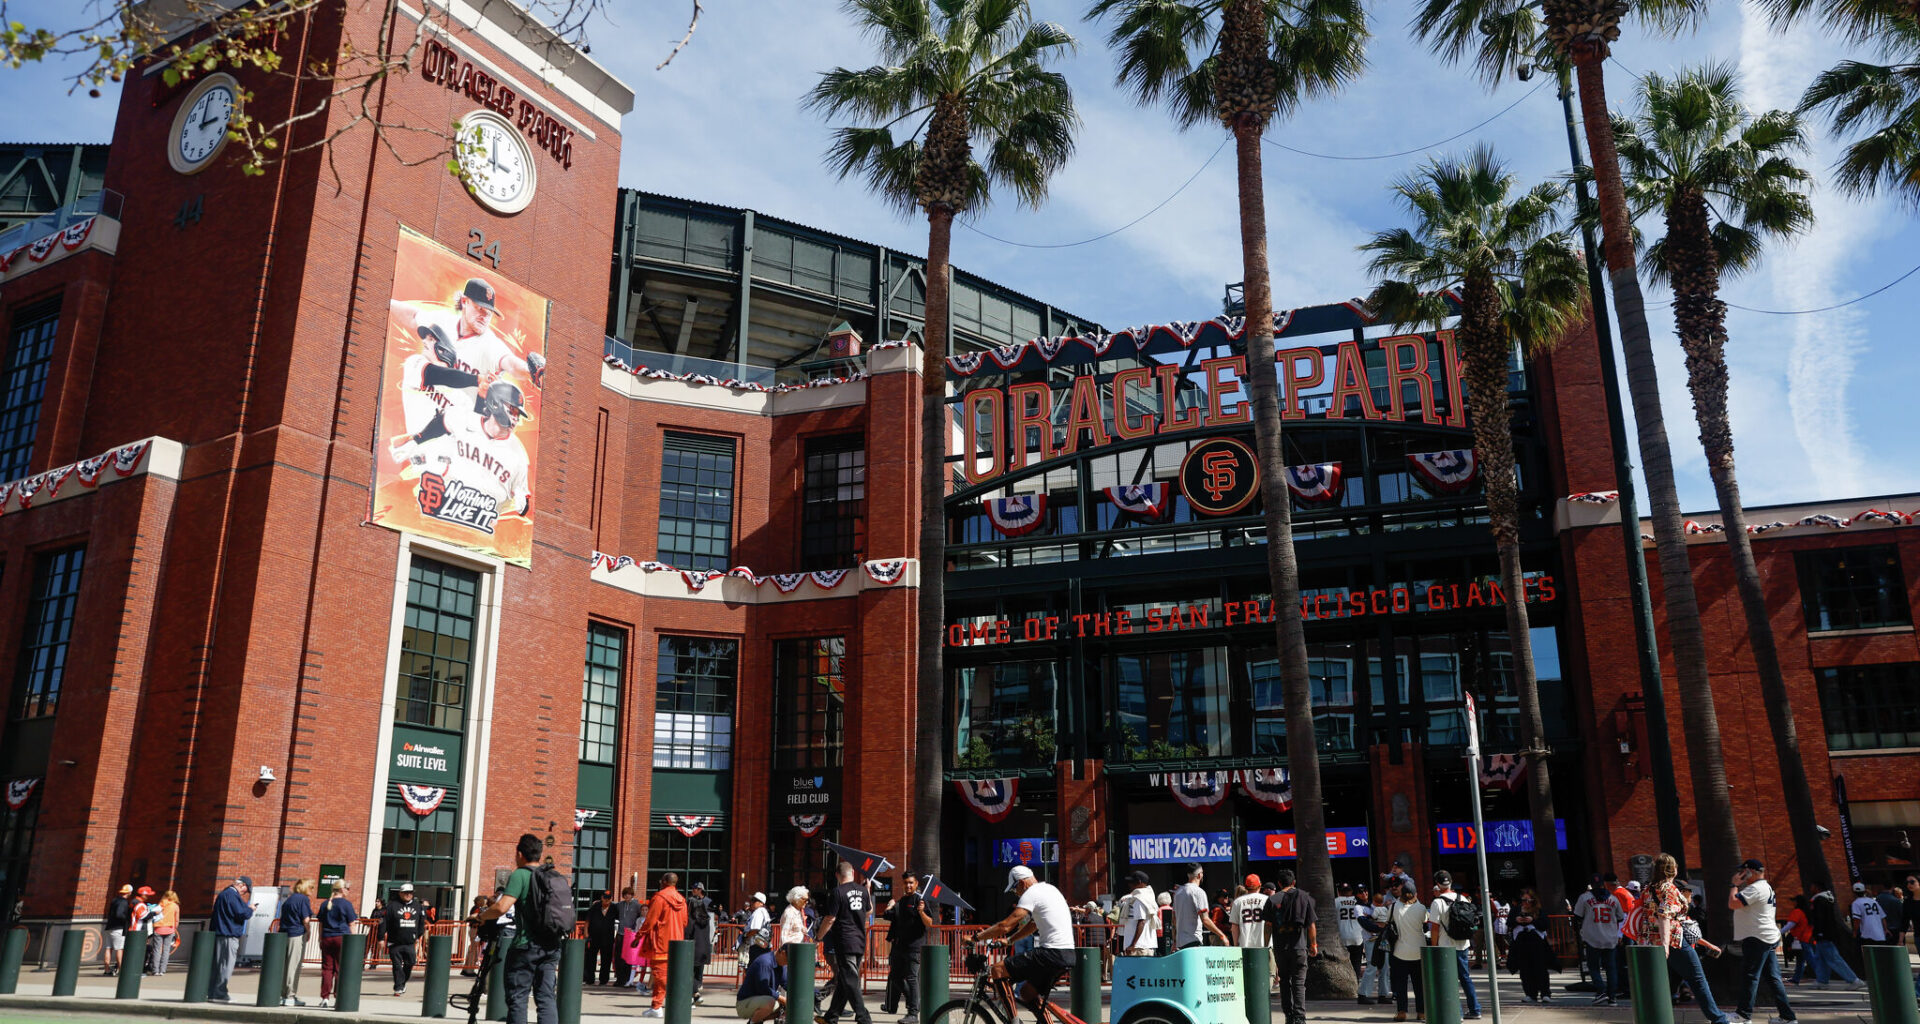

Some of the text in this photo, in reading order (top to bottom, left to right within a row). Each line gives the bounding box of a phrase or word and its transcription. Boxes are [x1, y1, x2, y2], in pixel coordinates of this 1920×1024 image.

[422, 39, 574, 170] ORACLE PARK
[189, 113, 197, 123] 10
[174, 194, 204, 229] 44
[467, 227, 501, 268] 24
[963, 355, 1250, 485] ORACLE
[457, 440, 510, 483] GIANTS
[1203, 450, 1239, 501] SF
[419, 472, 446, 515] SF
[440, 499, 478, 519] LIKE
[942, 618, 1011, 647] OME
[1024, 616, 1060, 641] OF
[1072, 610, 1133, 638] THE
[1147, 603, 1209, 632] SAN
[397, 754, 447, 771] SUITE LEVEL
[793, 776, 814, 787] blue
[1149, 771, 1208, 787] WILLIE
[1215, 769, 1263, 784] MAYS
[787, 792, 830, 804] FIELD CLUB
[1131, 837, 1251, 859] NIGHT 2026 Adoe
[1289, 837, 1338, 852] LE
[1242, 908, 1264, 923] 28
[1593, 907, 1611, 923] 15
[1864, 902, 1880, 915] 24
[1205, 957, 1216, 969] Your
[1217, 957, 1227, 971] only
[1139, 978, 1186, 988] ELISITY
[1206, 973, 1235, 988] Wishing you
[1207, 992, 1237, 1003] knew sooner.
